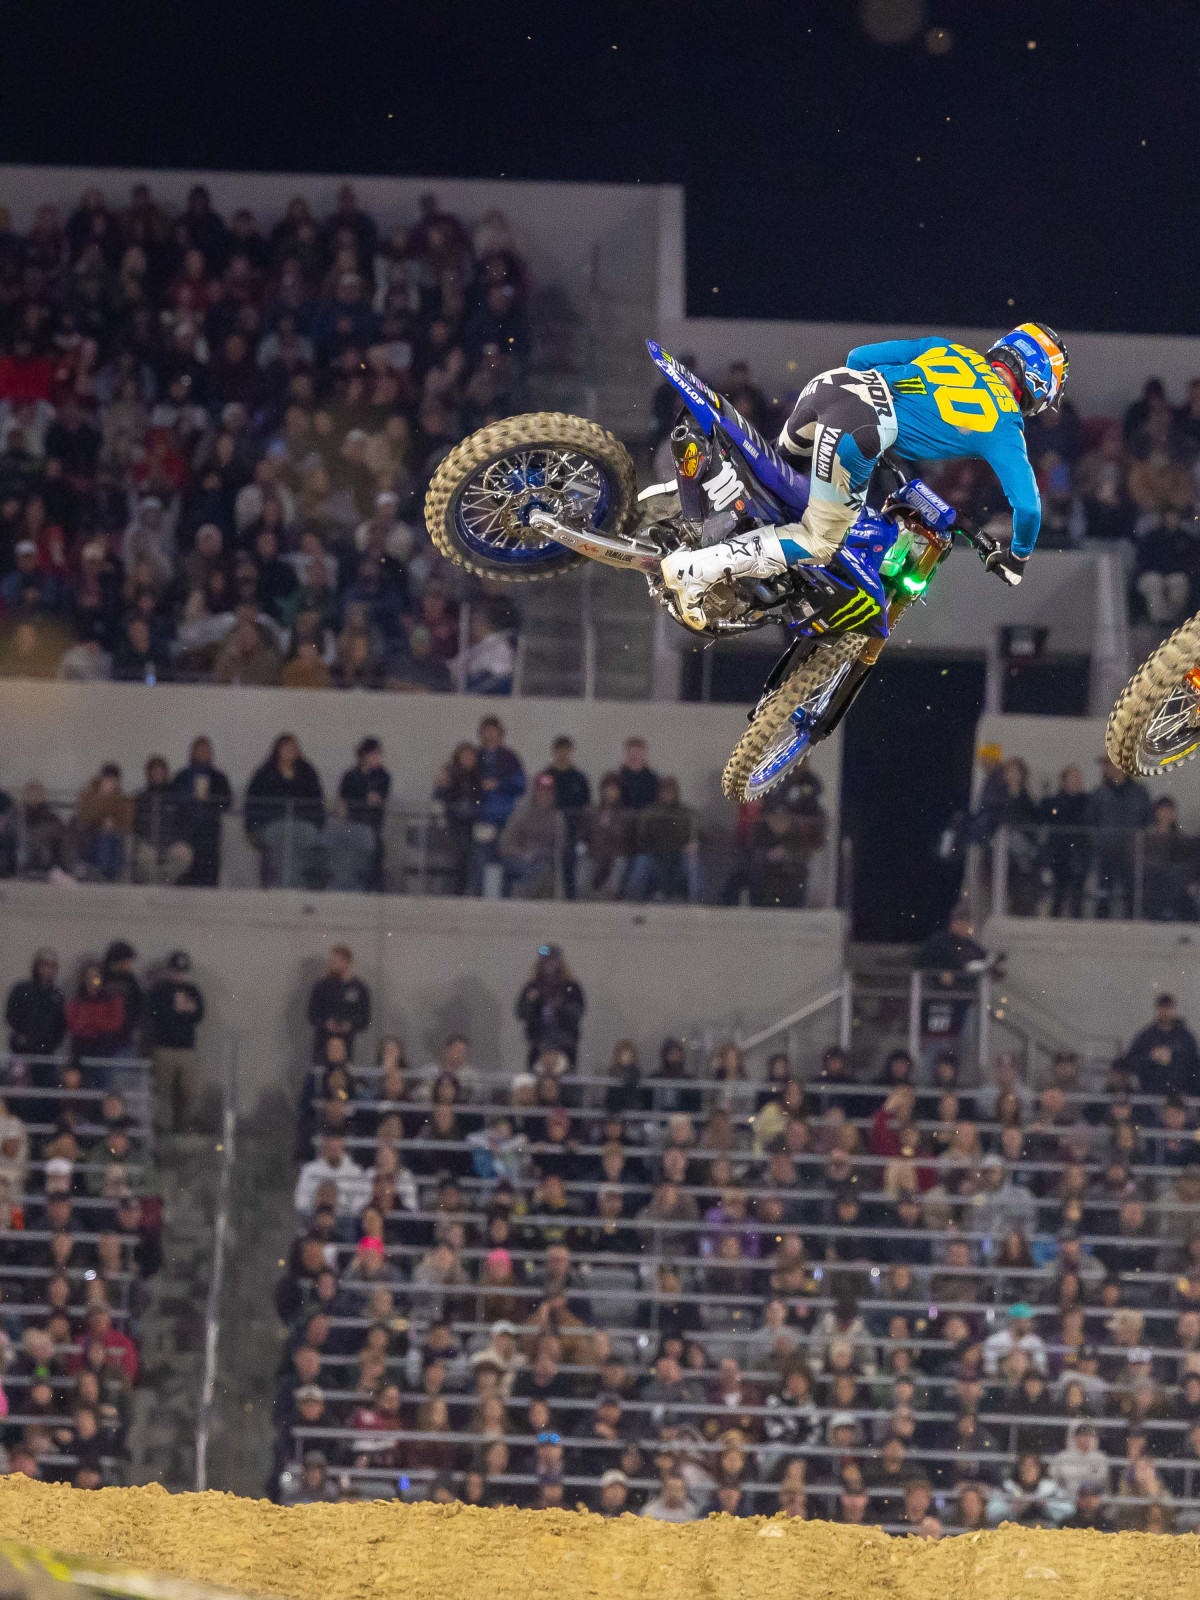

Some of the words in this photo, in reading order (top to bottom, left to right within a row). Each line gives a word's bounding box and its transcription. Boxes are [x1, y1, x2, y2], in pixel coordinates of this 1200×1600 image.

[664, 363, 706, 406] DUNLOP
[860, 371, 893, 418] THOR
[911, 346, 999, 433] 100
[742, 439, 760, 460] YAMAHA
[817, 426, 842, 479] YAMAHA
[906, 488, 941, 524] PROTAPER
